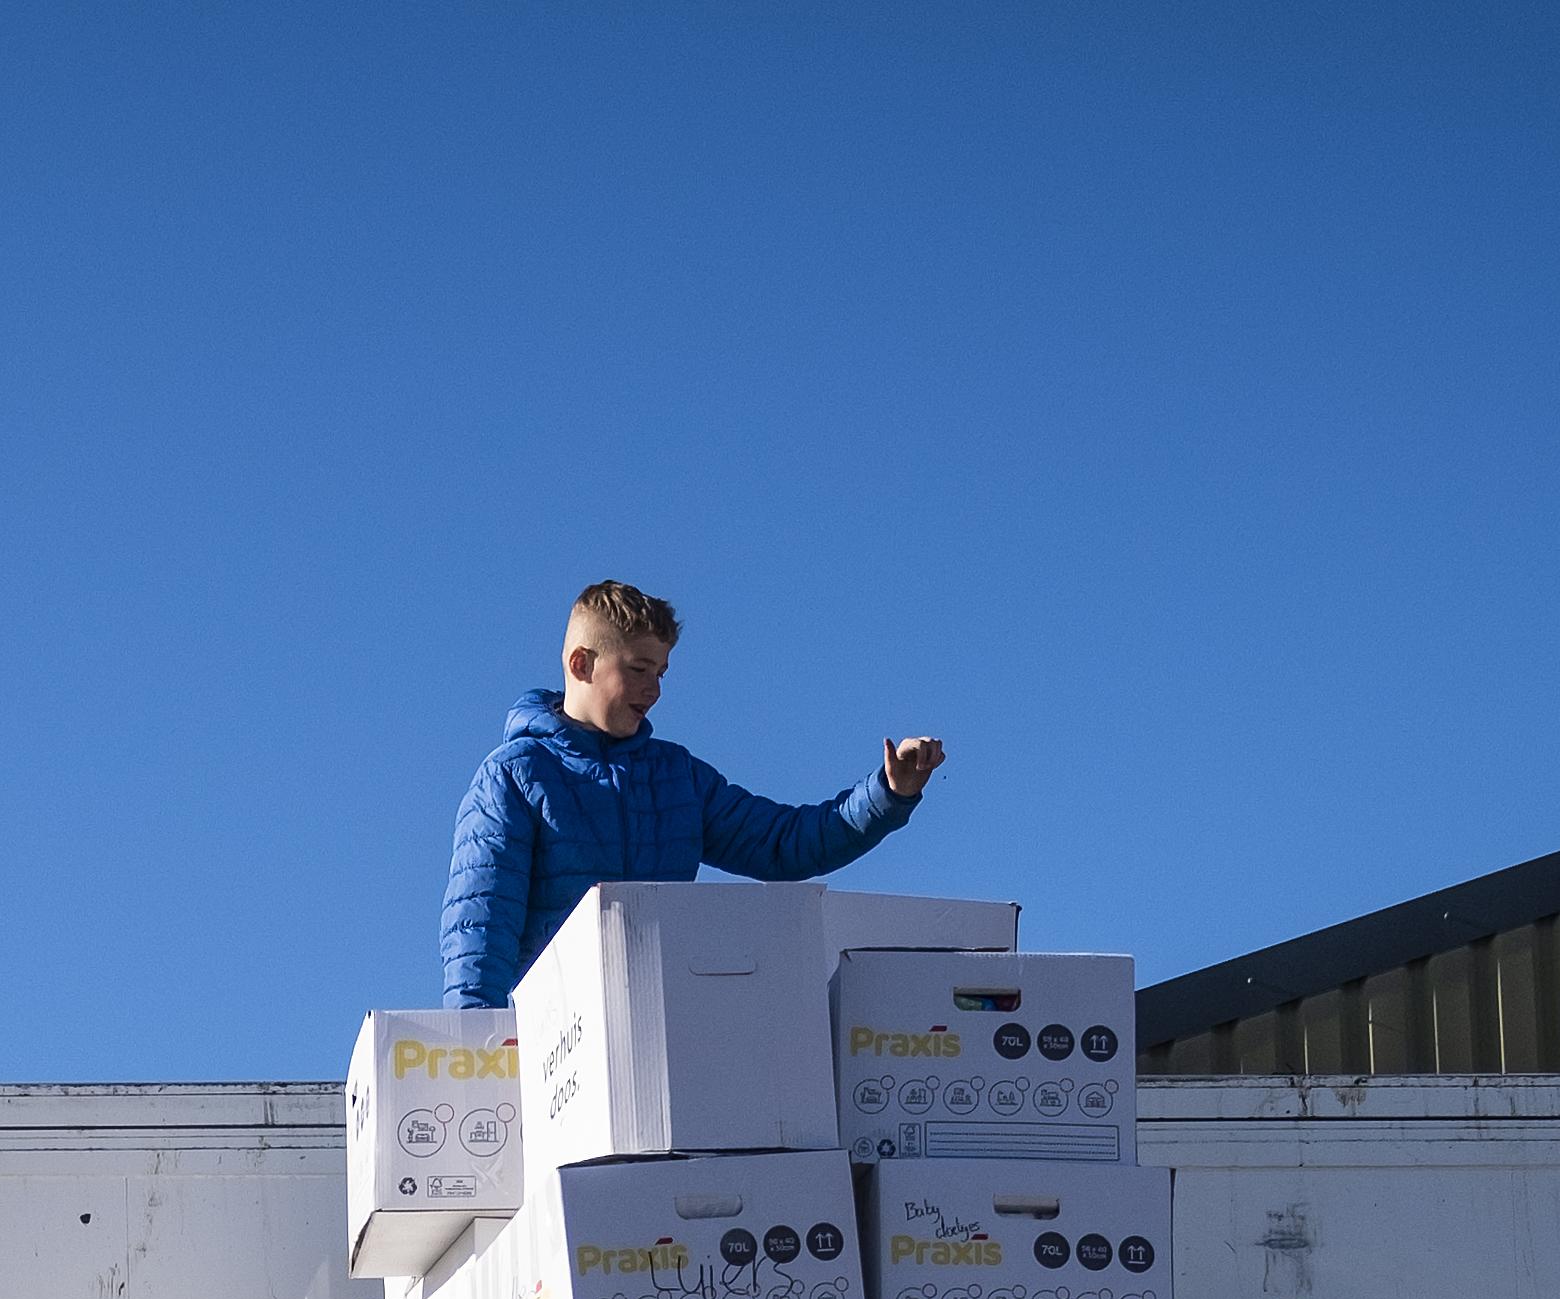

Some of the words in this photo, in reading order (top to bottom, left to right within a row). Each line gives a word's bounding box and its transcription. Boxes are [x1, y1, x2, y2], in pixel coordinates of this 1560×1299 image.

[542, 1011, 582, 1083] verhuis
[848, 1024, 962, 1058] Praxis
[1001, 1035, 1023, 1048] 70L
[549, 1070, 581, 1120] doos.
[904, 1199, 940, 1224] Baby
[576, 1237, 690, 1277] Praxis
[727, 1241, 750, 1253] 70L
[890, 1233, 1003, 1266] Praxis
[1041, 1244, 1063, 1256] 70L
